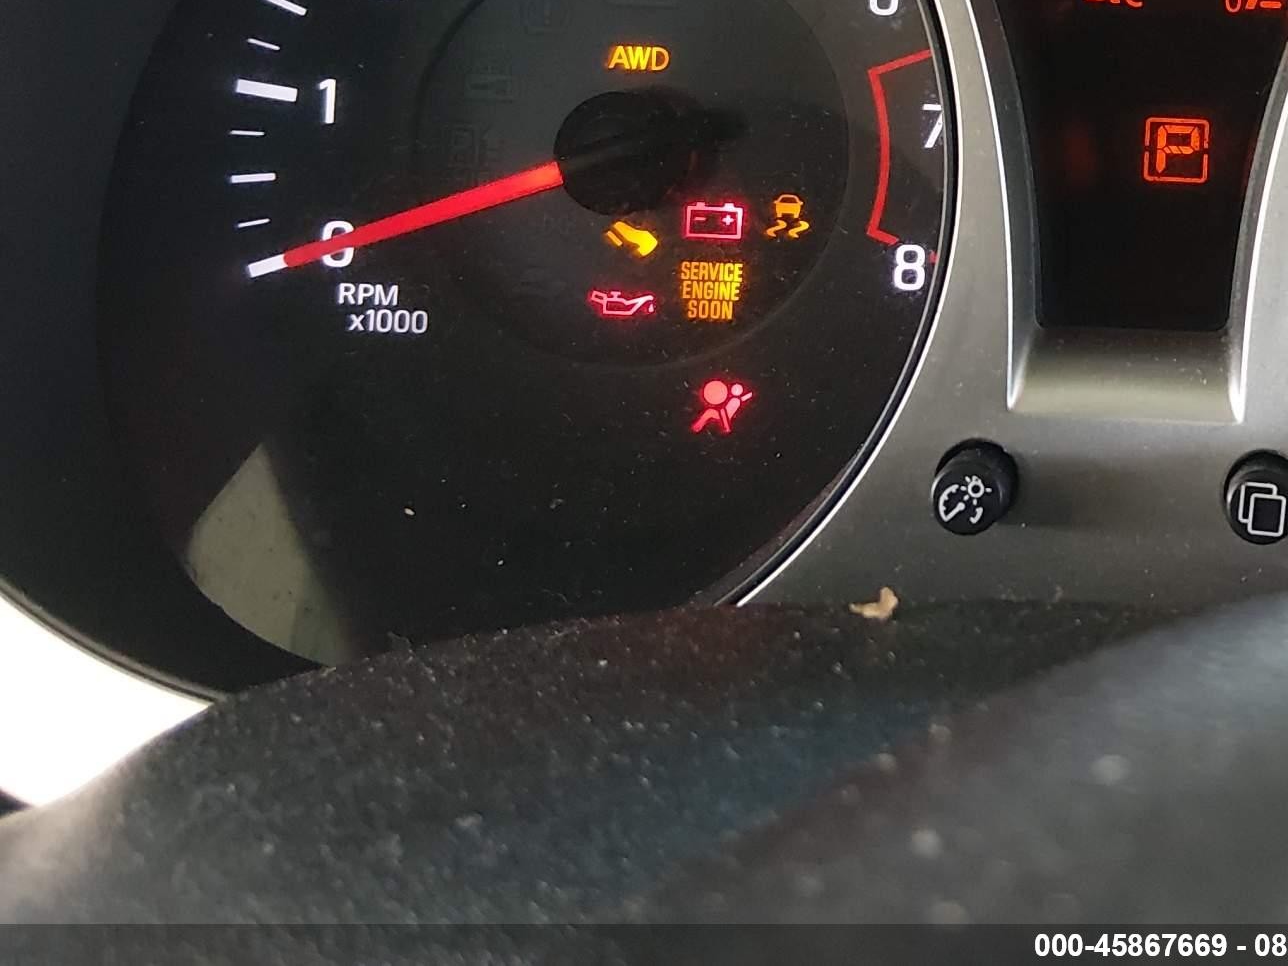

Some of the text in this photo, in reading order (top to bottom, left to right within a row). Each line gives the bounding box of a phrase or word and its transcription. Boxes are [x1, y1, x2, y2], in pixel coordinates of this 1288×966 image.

[607, 45, 670, 71] AWD
[318, 78, 337, 125] 1
[1155, 124, 1201, 174] P
[681, 261, 743, 281] SERVICE
[892, 243, 926, 291] 8
[337, 282, 399, 306] RPM
[682, 280, 741, 301] ENGINE
[348, 308, 428, 334] x1000
[687, 299, 734, 320] SOON
